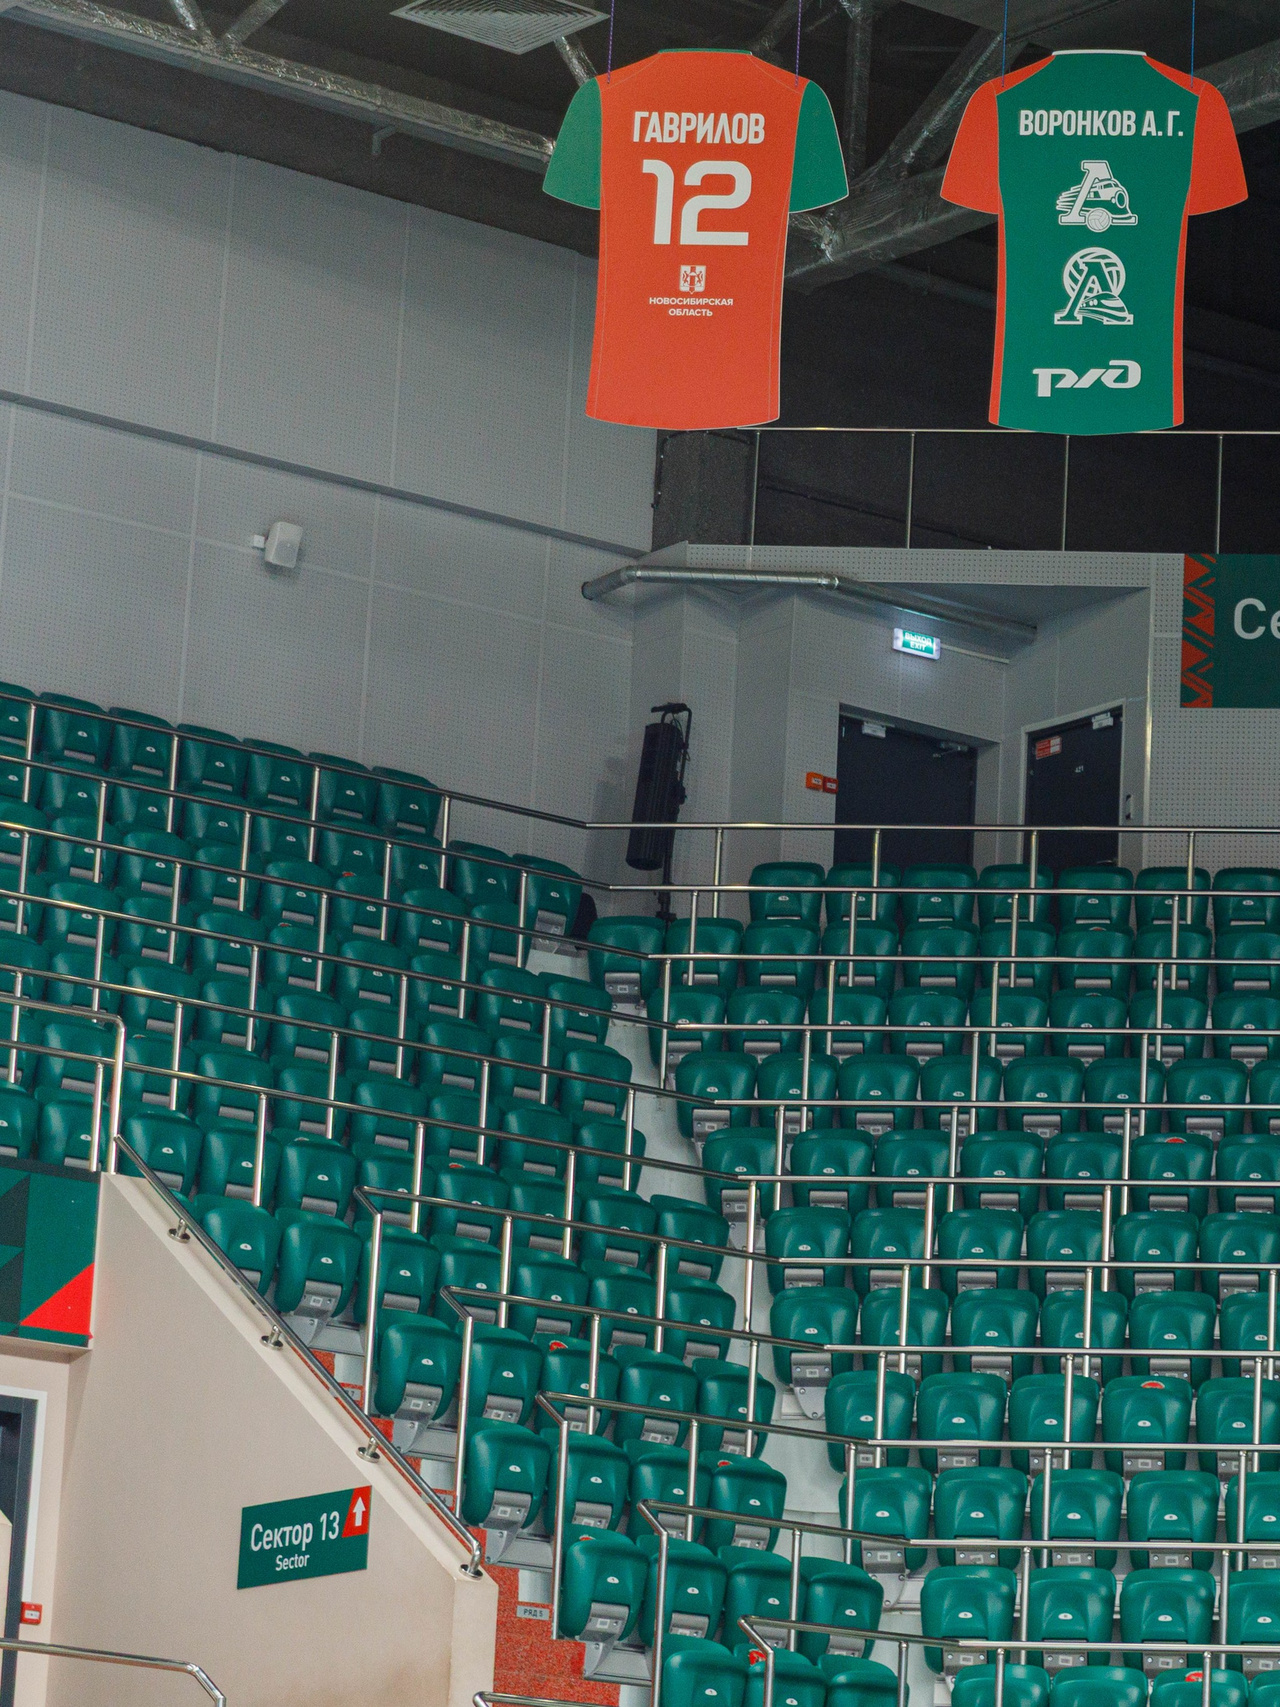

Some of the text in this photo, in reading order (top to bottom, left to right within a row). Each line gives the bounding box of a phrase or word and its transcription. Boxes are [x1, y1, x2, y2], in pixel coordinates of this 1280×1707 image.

[632, 110, 765, 145] ГАВРИЛОВ
[1019, 109, 1137, 137] ВОРОНКОВ
[642, 159, 752, 246] 12
[648, 295, 735, 306] НОВОСИБИРСКАЯ
[668, 307, 714, 317] ОБЛАСТЬ
[909, 641, 927, 651] EXIT
[250, 1511, 340, 1552] Сектор 13
[275, 1553, 310, 1571] Sector
